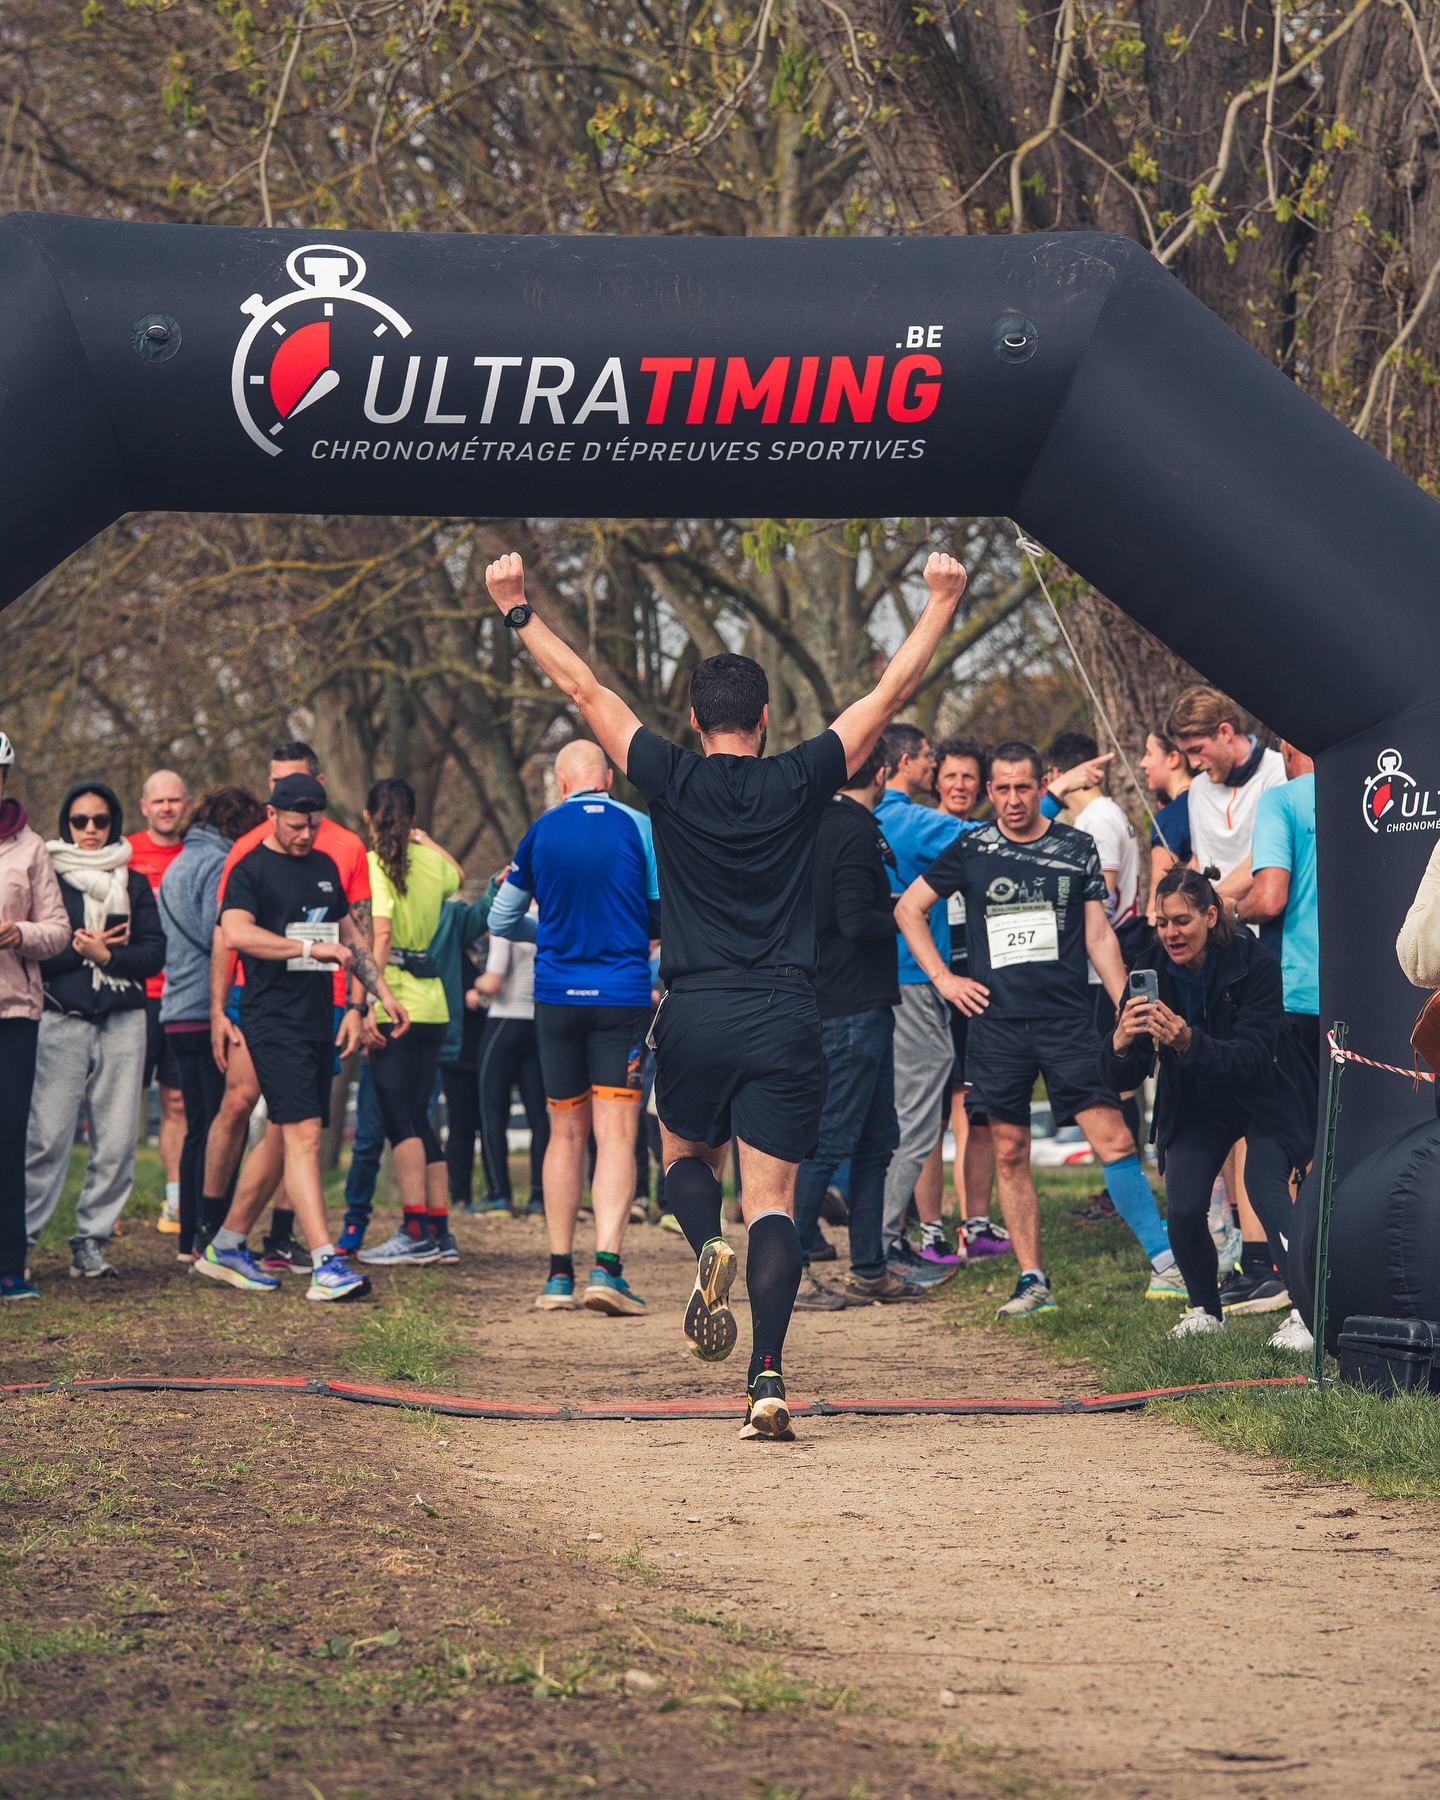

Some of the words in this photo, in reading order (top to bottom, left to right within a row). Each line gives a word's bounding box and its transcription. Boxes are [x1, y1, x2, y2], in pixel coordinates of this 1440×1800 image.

[895, 325, 944, 349] .BE
[363, 353, 943, 425] ULTRATIMING
[311, 436, 575, 461] CHRONOMÉTRAGE
[582, 436, 762, 462] D'ÉPREUVES
[768, 439, 927, 461] SPORTIVES
[1401, 790, 1440, 818] UL
[1057, 875, 1071, 906] URBAN
[1007, 930, 1036, 947] 257
